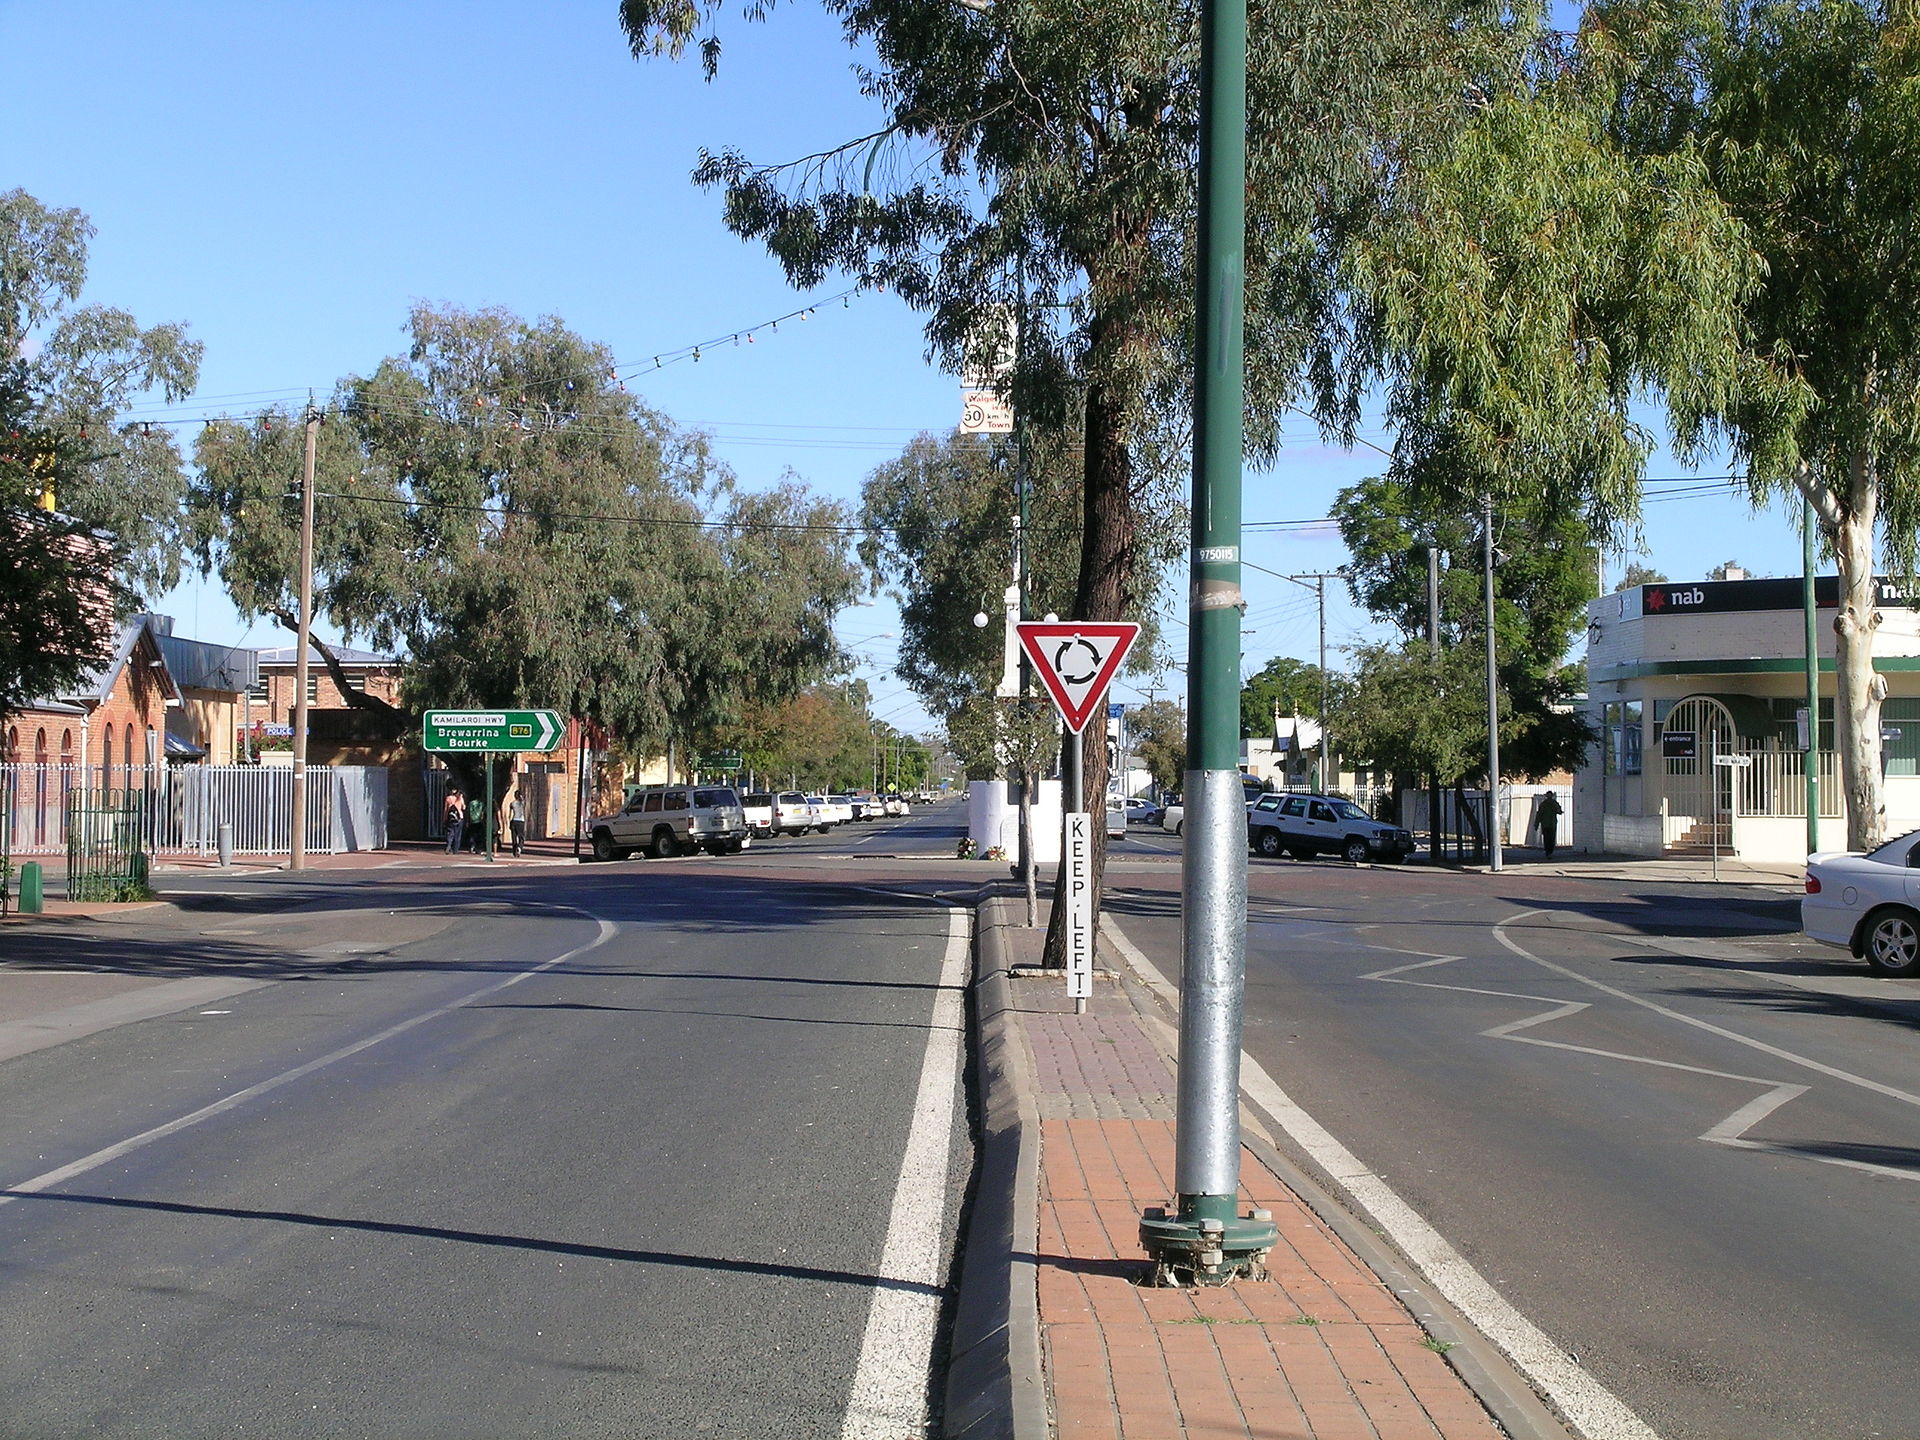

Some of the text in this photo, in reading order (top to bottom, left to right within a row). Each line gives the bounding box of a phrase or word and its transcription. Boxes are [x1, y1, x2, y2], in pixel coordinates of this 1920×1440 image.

[964, 410, 981, 422] 50
[987, 421, 1010, 429] Town
[1199, 548, 1233, 560] 9750115
[1671, 587, 1705, 606] nab
[433, 716, 504, 724] KAMILAROI HWY
[438, 728, 500, 738] Brewarrina
[511, 726, 529, 736] B76
[449, 738, 488, 748] Bourke
[1072, 820, 1085, 990] KEEP LEFT
